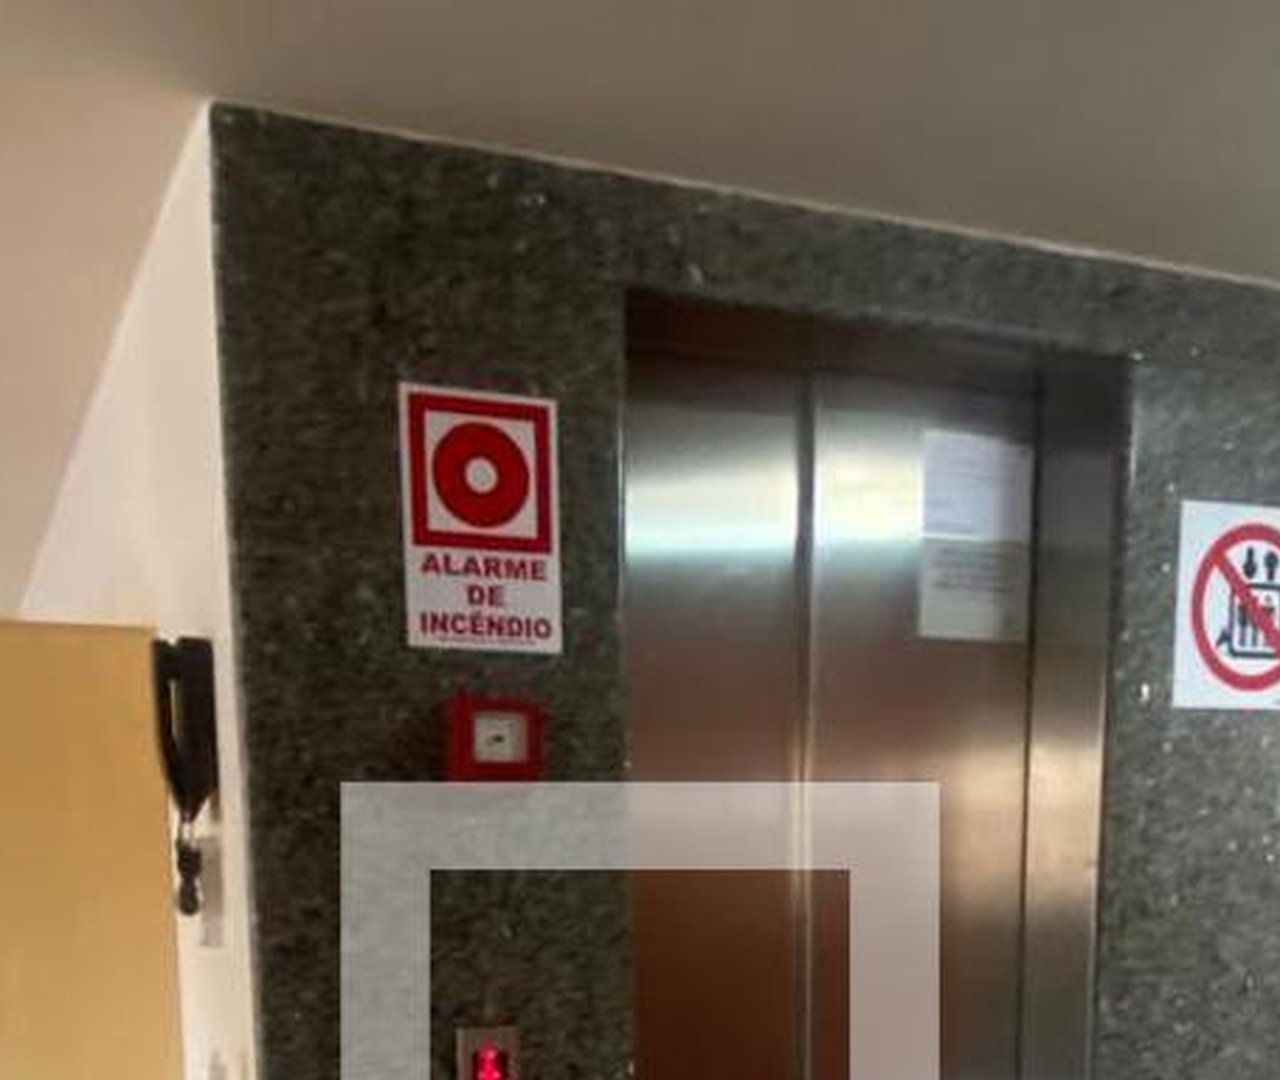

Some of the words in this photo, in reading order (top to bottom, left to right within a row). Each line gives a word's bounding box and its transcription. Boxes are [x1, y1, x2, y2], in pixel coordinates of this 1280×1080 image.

[421, 552, 547, 581] ALARME
[467, 585, 505, 607] DE
[419, 609, 552, 639] INCÊNDIO
